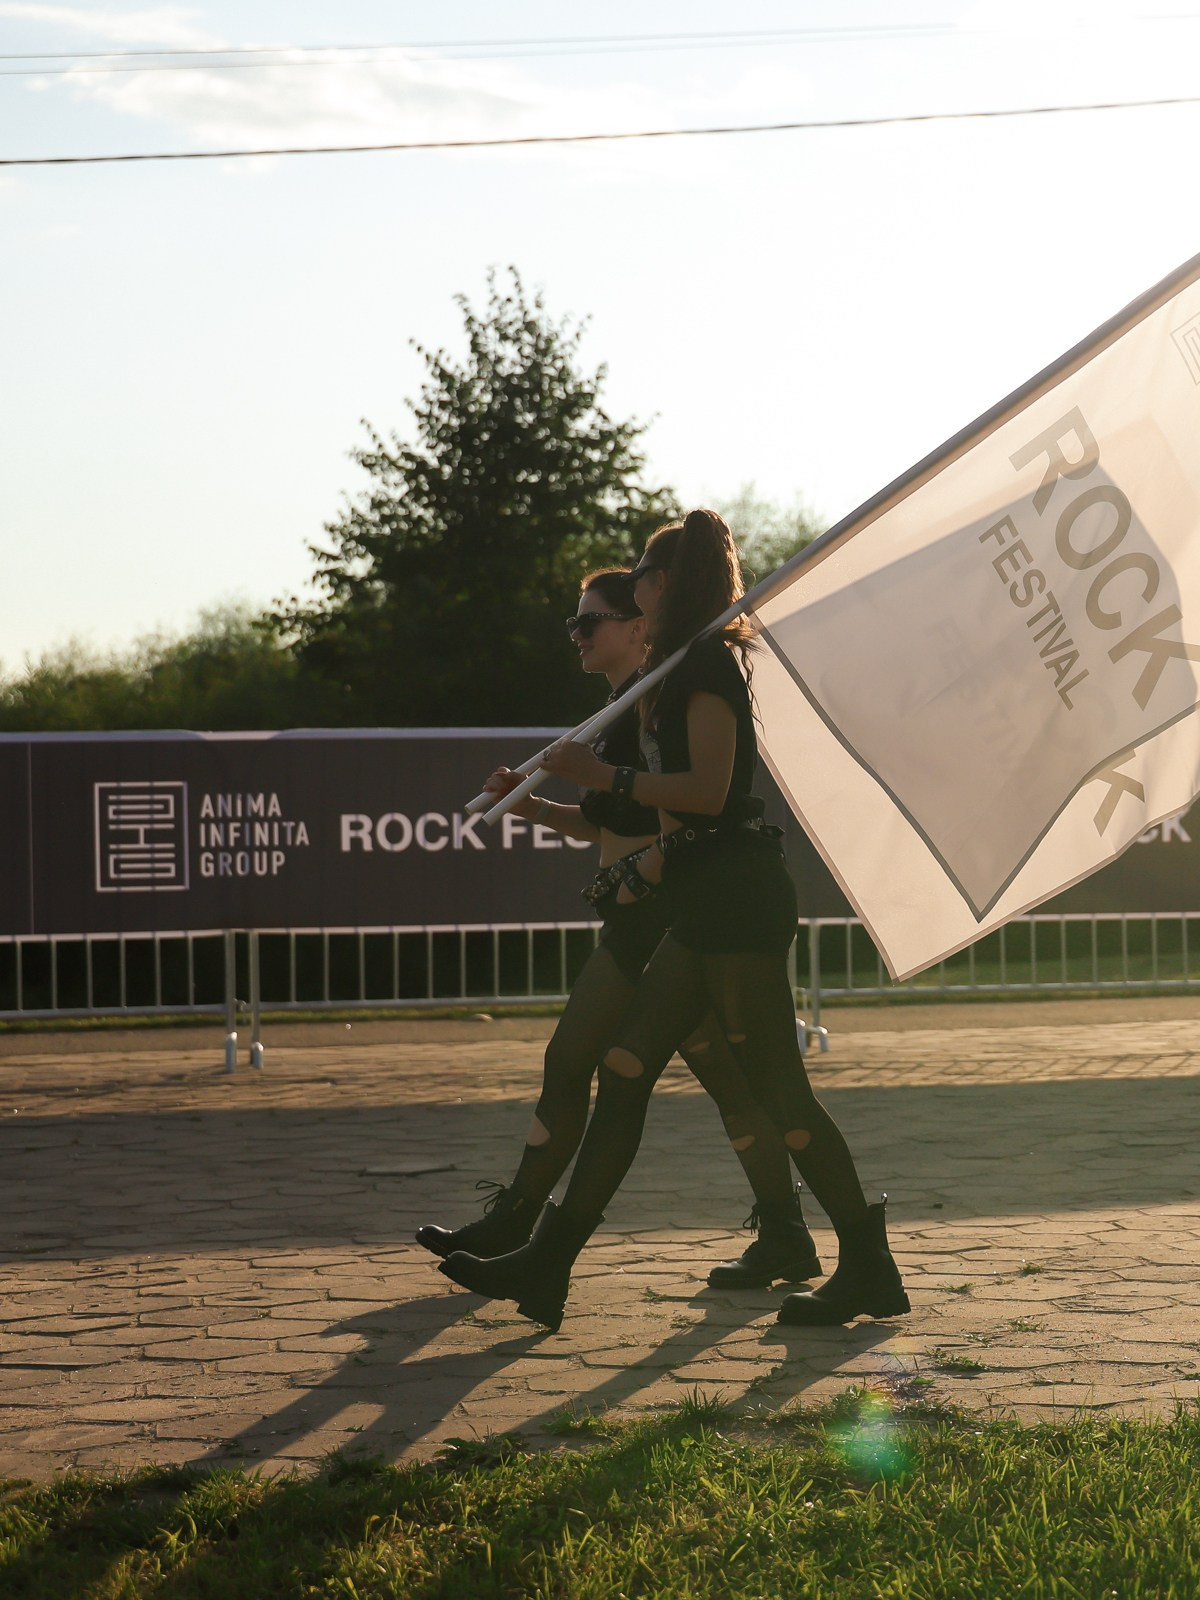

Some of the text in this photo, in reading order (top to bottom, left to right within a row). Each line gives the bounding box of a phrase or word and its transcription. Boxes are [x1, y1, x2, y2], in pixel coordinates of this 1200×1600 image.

[978, 514, 1090, 712] FESTIVAL
[200, 792, 283, 818] ANIMA
[200, 821, 310, 847] INFINITA
[340, 812, 487, 852] ROCK
[201, 850, 286, 877] GROUP
